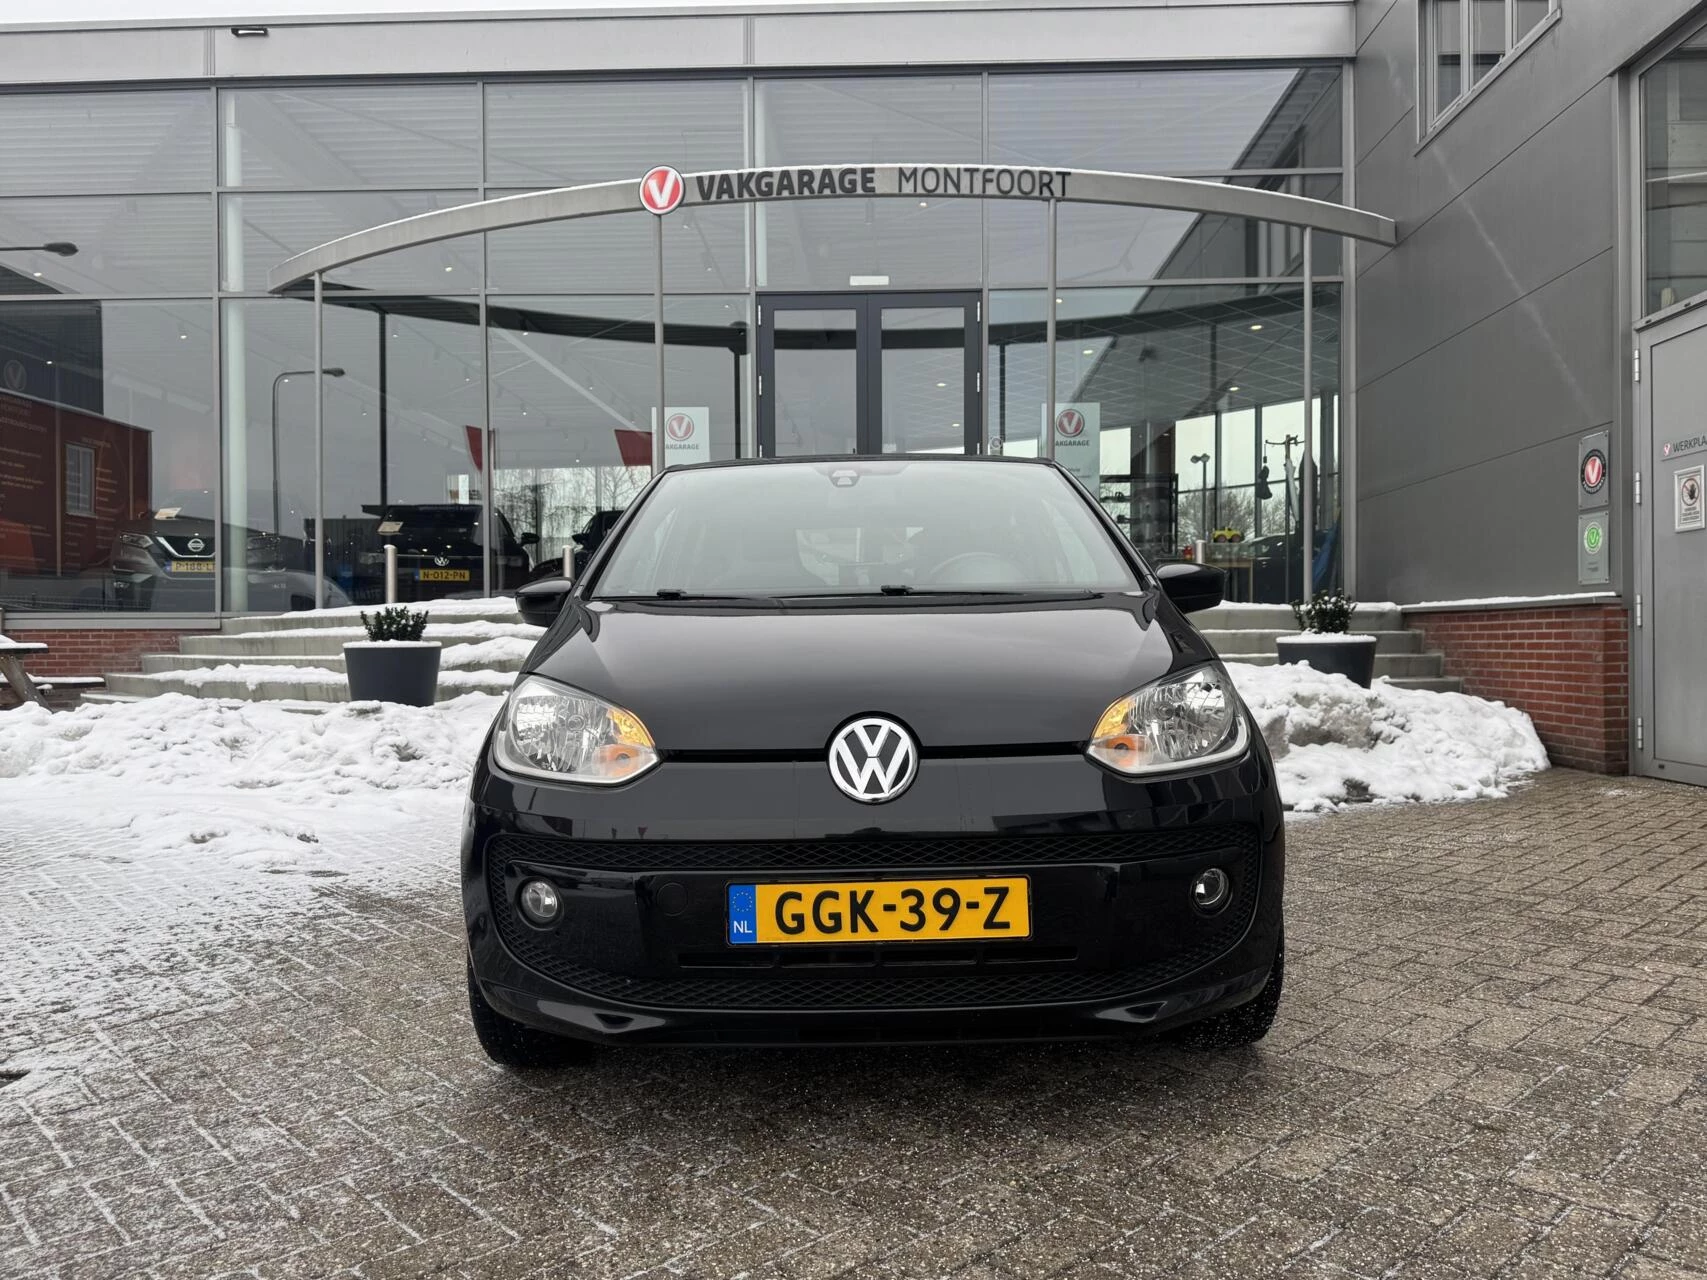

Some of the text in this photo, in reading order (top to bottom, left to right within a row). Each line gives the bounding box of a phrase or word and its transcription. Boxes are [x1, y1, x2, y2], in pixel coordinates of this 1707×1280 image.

[696, 167, 876, 201] VAKGARAGE
[898, 167, 1072, 197] MONTFOORT
[423, 571, 466, 579] N-012-PN
[733, 886, 1011, 935] NL GGK-39-Z
